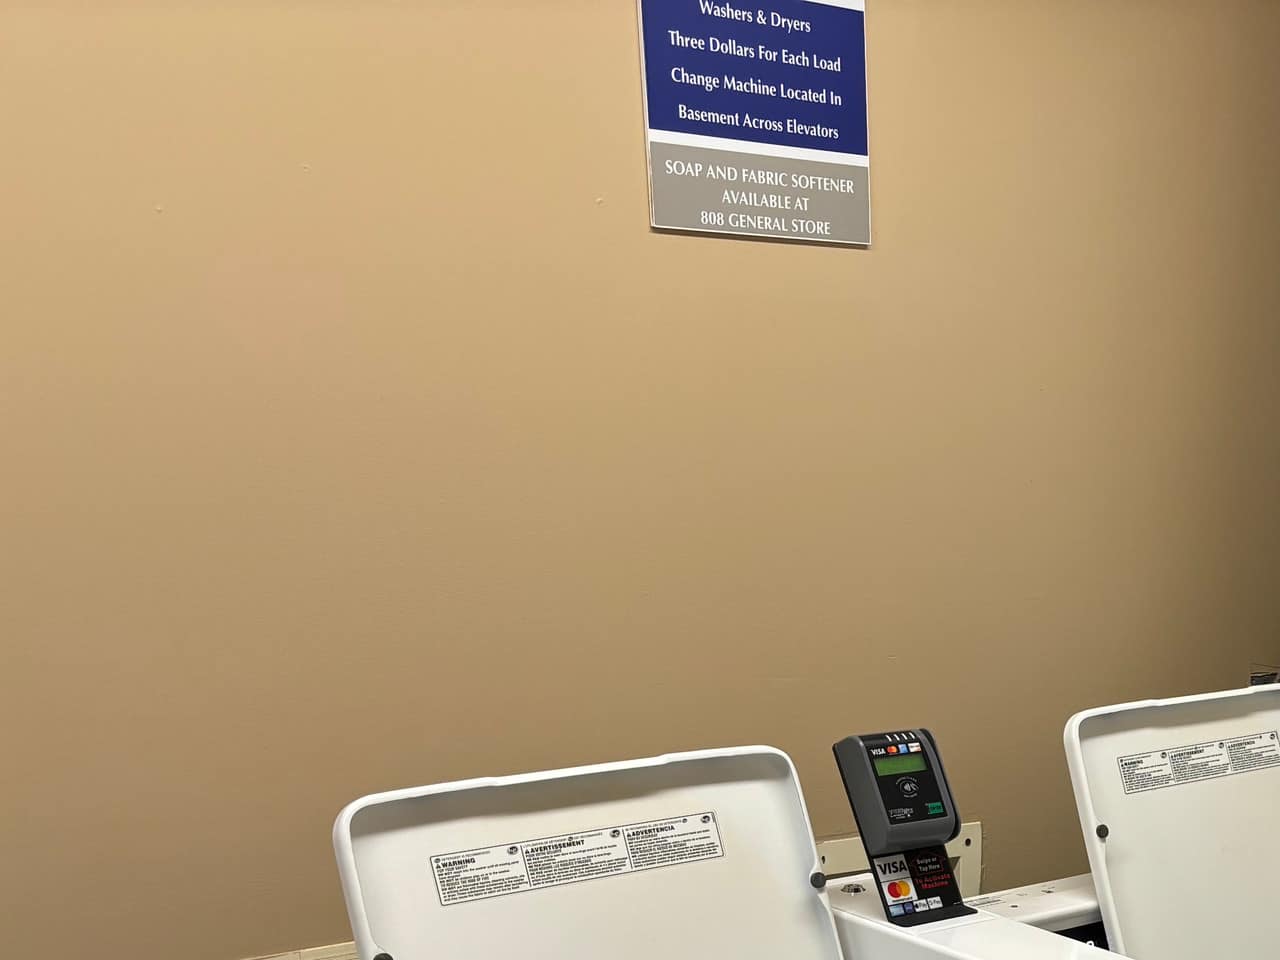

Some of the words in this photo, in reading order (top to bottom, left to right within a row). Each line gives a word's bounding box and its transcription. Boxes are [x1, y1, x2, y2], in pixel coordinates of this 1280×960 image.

[699, 1, 753, 23] Washers
[757, 10, 767, 25] &
[771, 12, 811, 33] Dryers
[668, 30, 705, 50] Three
[710, 37, 754, 58] Dollars
[758, 46, 778, 62] For
[782, 50, 809, 68] Each
[813, 54, 841, 72] Load
[671, 67, 720, 92] Change
[723, 75, 777, 97] Machine
[780, 84, 826, 104] Located
[830, 91, 842, 106] In
[678, 104, 739, 127] Basement
[743, 115, 783, 132] Across
[787, 120, 839, 140] Elevators
[665, 159, 703, 177] SOAP
[706, 165, 738, 181] AND
[742, 169, 788, 187] FABRIC
[791, 174, 855, 194] SOFTENER
[722, 190, 791, 210] AVAILABLE
[794, 197, 810, 211] AT
[700, 211, 724, 226] 808
[728, 213, 788, 232] GENERAL
[791, 219, 831, 235] STORE
[871, 747, 886, 756] VISA
[632, 825, 675, 836] ADVERTENCIA
[530, 839, 585, 854] AVERTISSEMENT
[441, 857, 476, 868] WARNING
[877, 860, 908, 875] VISA
